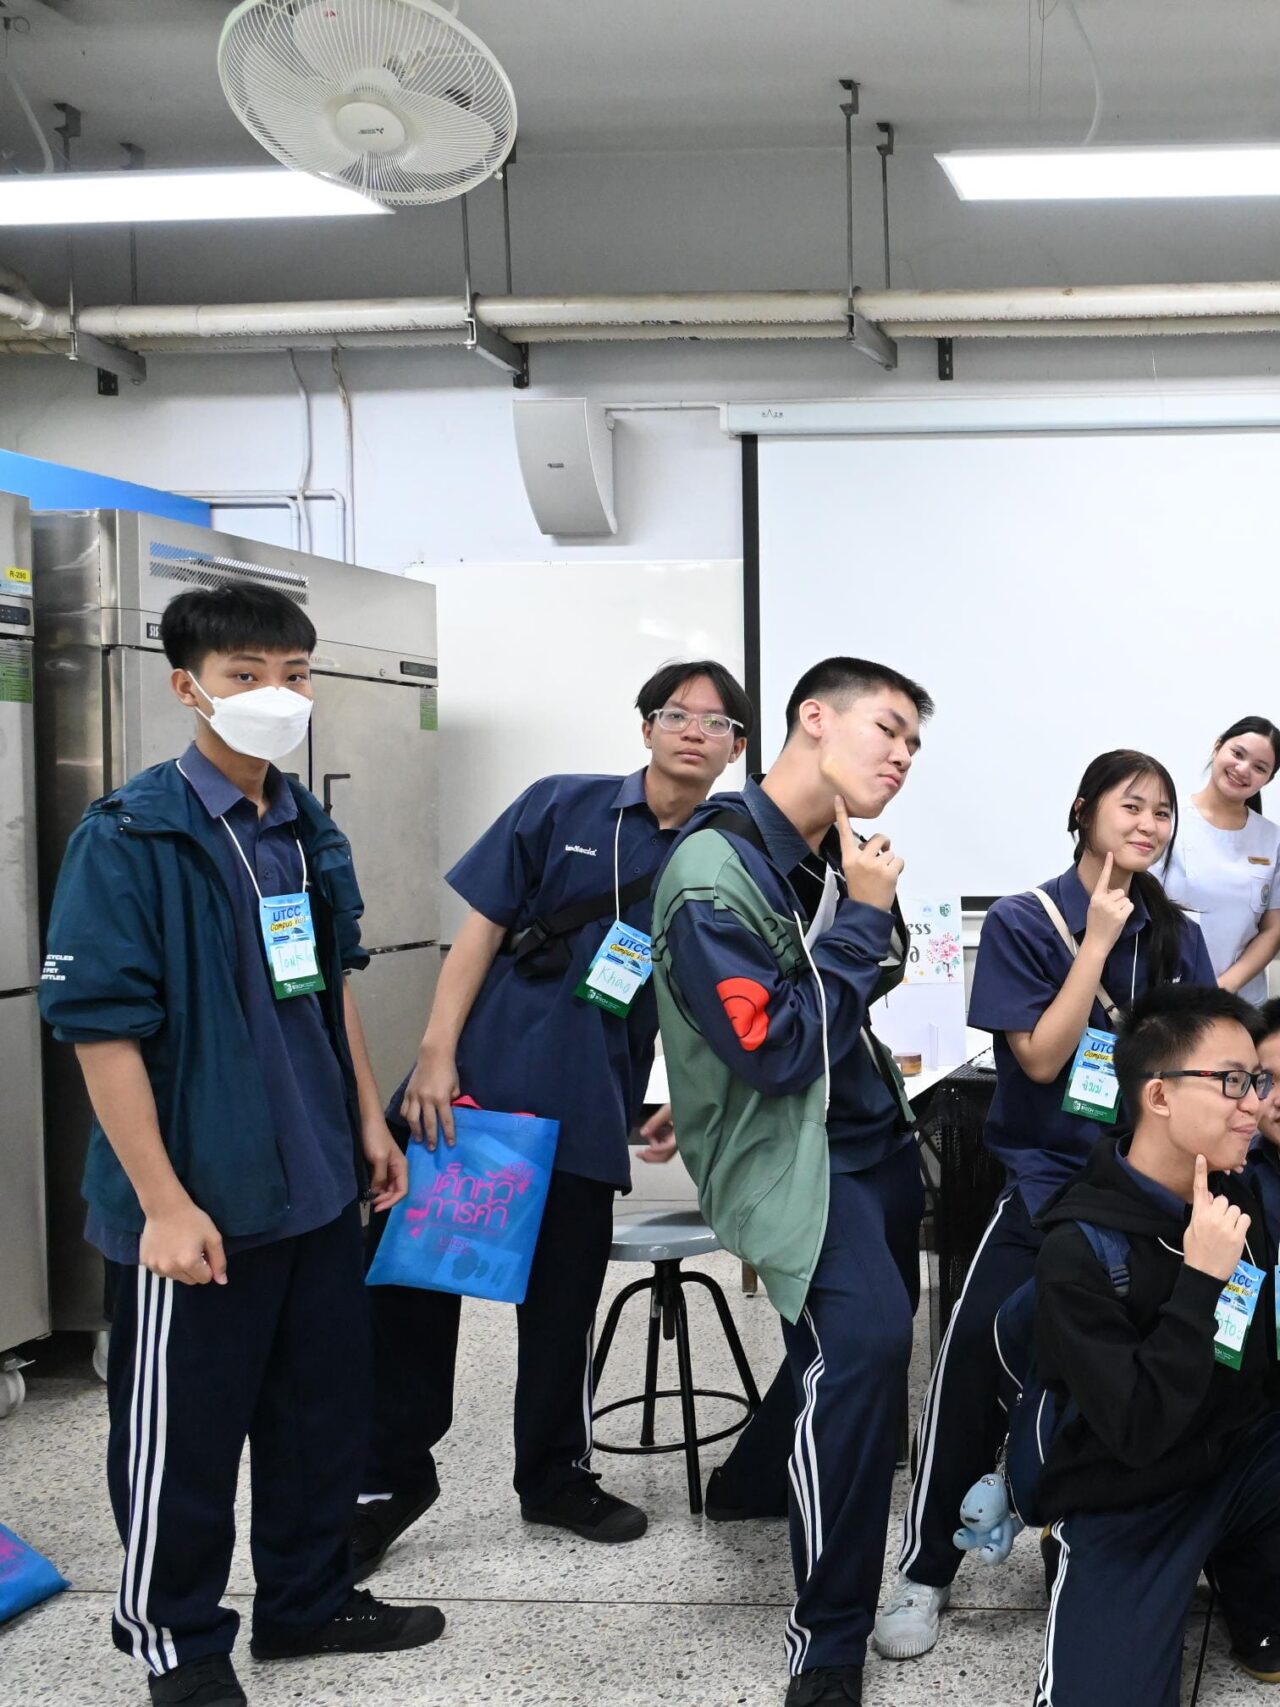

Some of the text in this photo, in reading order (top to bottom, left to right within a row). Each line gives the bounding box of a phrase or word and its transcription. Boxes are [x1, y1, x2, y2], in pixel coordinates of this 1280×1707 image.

[273, 906, 302, 922] UTCC
[618, 937, 651, 956] UTCC
[1091, 1041, 1114, 1054] UTC
